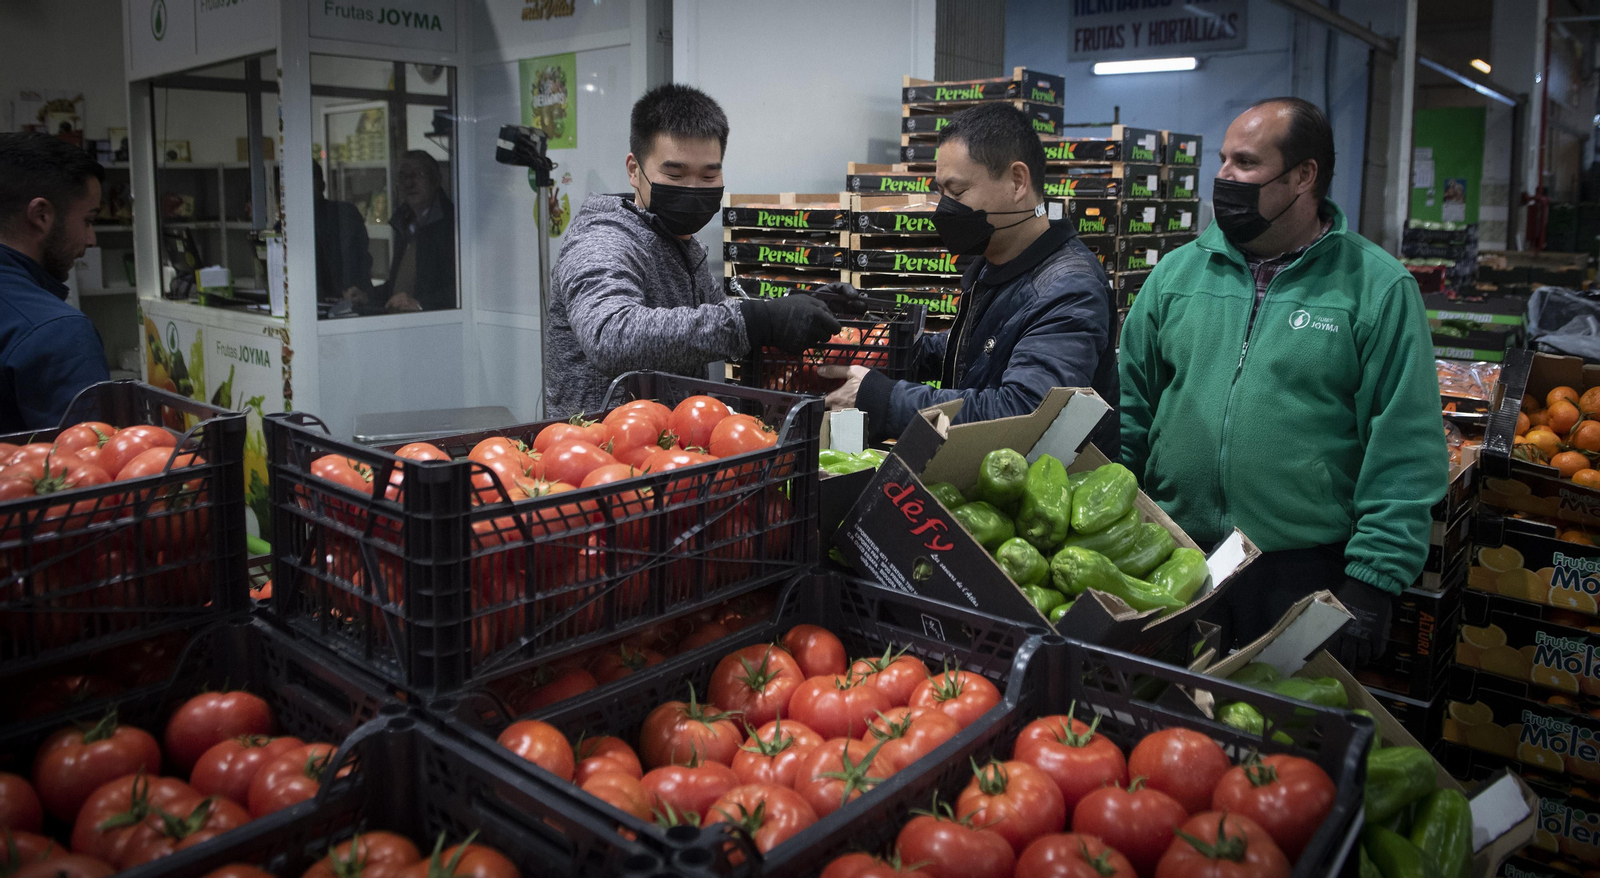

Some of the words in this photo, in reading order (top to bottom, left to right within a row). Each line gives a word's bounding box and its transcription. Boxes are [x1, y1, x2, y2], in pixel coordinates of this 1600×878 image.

[324, 0, 374, 22] Frutas
[376, 8, 443, 32] JOYMA
[1074, 23, 1126, 53] FRUTAS
[1132, 21, 1142, 48] Y
[1149, 12, 1239, 46] HORTALIZAS
[935, 83, 985, 101] Persik
[1031, 87, 1056, 103] Persik
[1031, 118, 1056, 134] Persik
[1043, 142, 1079, 160] sik
[879, 176, 933, 193] Persik
[1043, 179, 1080, 197] sik
[756, 210, 811, 229] Persik
[893, 214, 937, 232] Pers
[1078, 216, 1107, 233] Persik
[1167, 218, 1190, 231] Per
[757, 246, 811, 265] Persik
[893, 252, 960, 273] Persik
[1127, 255, 1152, 269] Pers
[1311, 320, 1339, 333] JOYMA
[215, 340, 238, 360] Frutas
[238, 345, 271, 369] JOYMA
[883, 481, 954, 552] défy
[1416, 610, 1436, 657] ALTURA
[1535, 630, 1587, 653] Frutas
[1521, 708, 1573, 733] Frutas
[1519, 722, 1600, 763] Mole
[1540, 796, 1567, 815] tas
